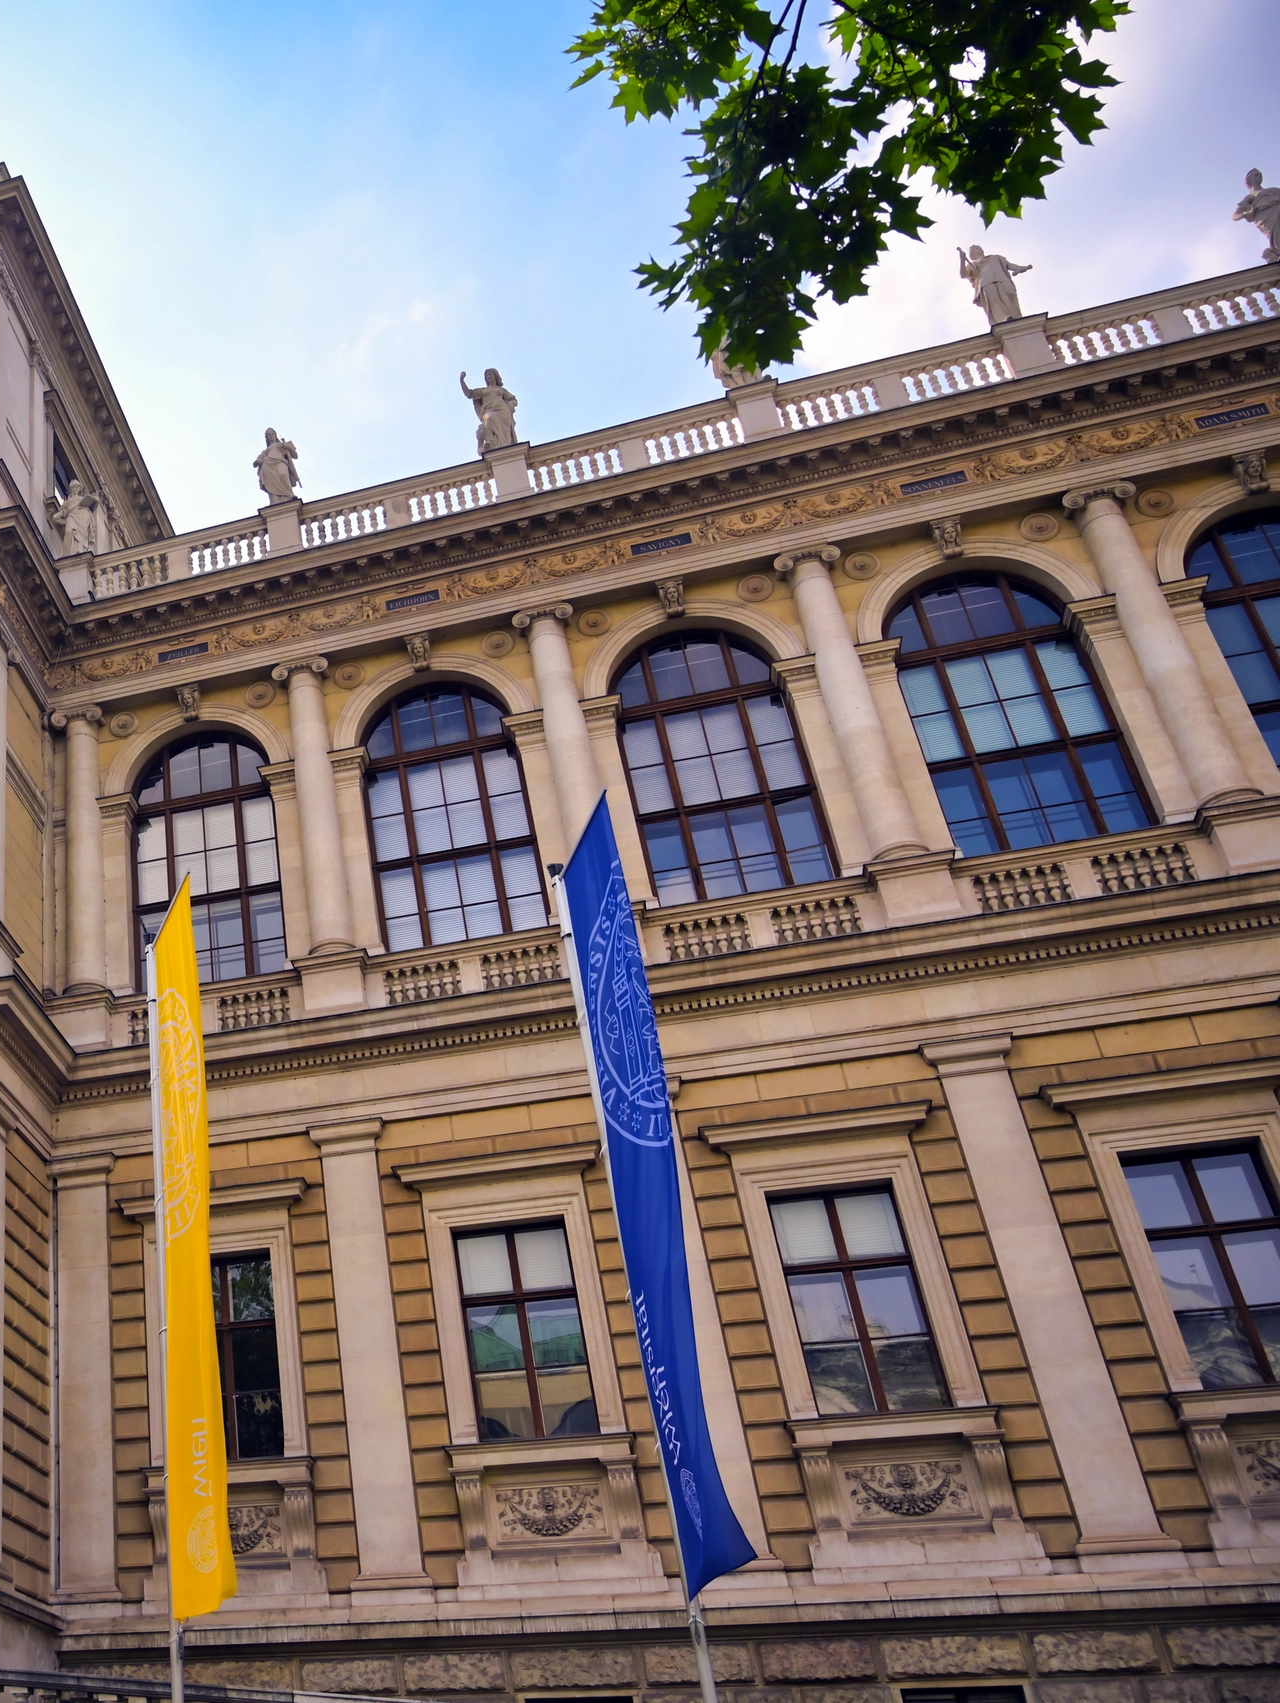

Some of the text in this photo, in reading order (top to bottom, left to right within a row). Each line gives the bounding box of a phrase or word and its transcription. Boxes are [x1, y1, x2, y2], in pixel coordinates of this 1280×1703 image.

[1198, 406, 1266, 427] ADAM SMITH
[901, 474, 966, 493] SONNENFELS
[389, 594, 435, 609] EICHHORN
[166, 646, 201, 660] ZEILLER
